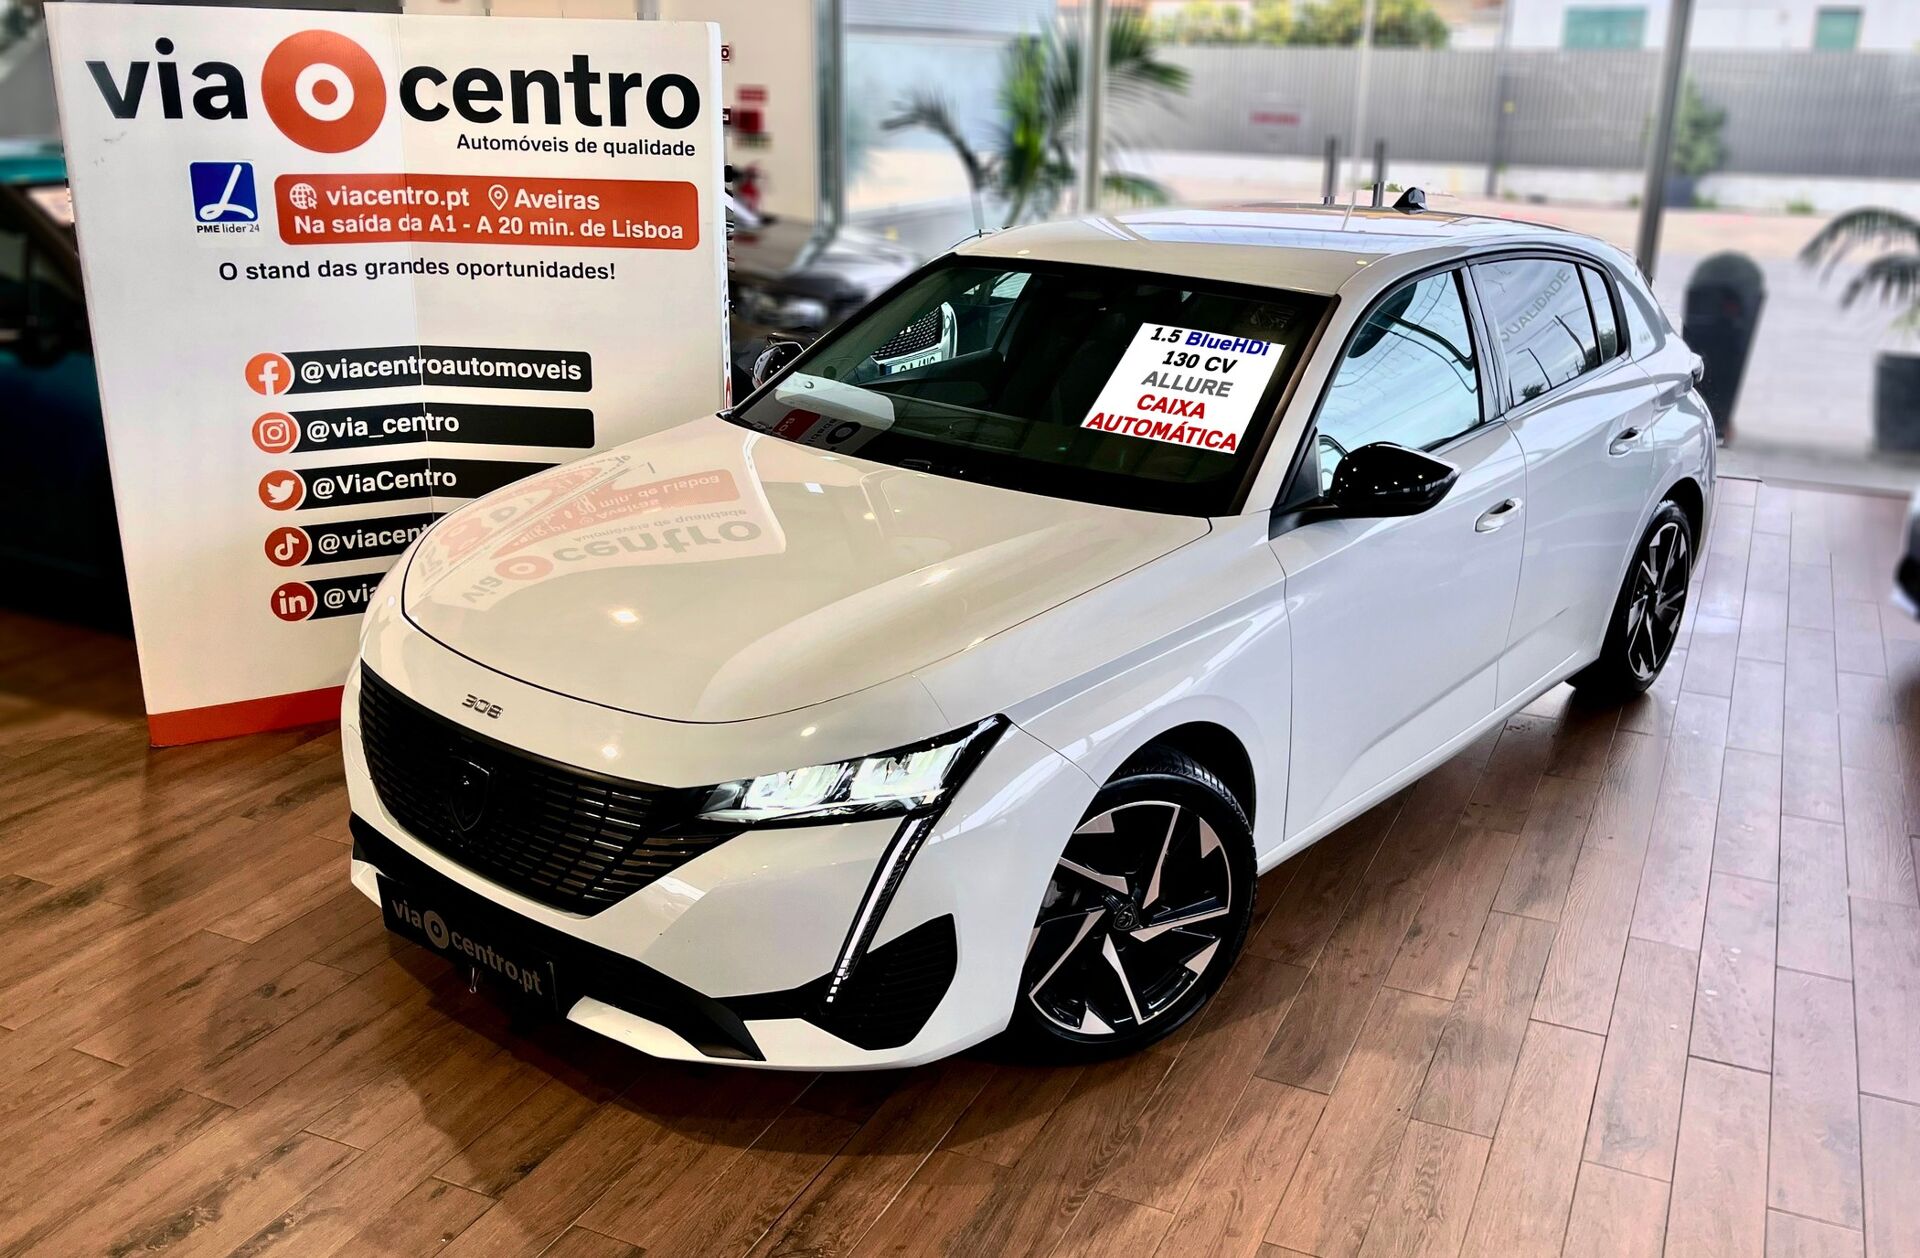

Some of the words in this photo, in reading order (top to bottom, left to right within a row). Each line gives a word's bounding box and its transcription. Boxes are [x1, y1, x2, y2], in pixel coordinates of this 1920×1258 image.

[86, 38, 248, 120] via
[400, 54, 701, 130] centro
[456, 133, 570, 153] Automóveis
[574, 137, 598, 154] de
[603, 138, 696, 158] qualidade
[326, 186, 470, 210] viacentro.pt
[514, 188, 600, 211] Aveiras
[197, 224, 220, 234] PME
[294, 216, 325, 234] Na
[331, 213, 392, 233] saída
[398, 213, 423, 232] da
[429, 214, 457, 233] A1
[476, 216, 493, 234] A
[498, 216, 523, 235] 20
[529, 217, 575, 236] min.
[580, 218, 606, 237] de
[612, 219, 684, 240] Lisboa
[219, 262, 238, 281] O
[246, 260, 310, 280] stand
[317, 259, 358, 278] das
[364, 257, 450, 280] grandes
[456, 260, 615, 280] oportunidades!
[301, 355, 582, 384] @viacentroautomoveis
[306, 412, 460, 442] @via_centro
[312, 469, 457, 500] @ViaCentro
[462, 694, 503, 719] 308
[392, 899, 423, 929] via
[451, 931, 543, 996] centro.pt
